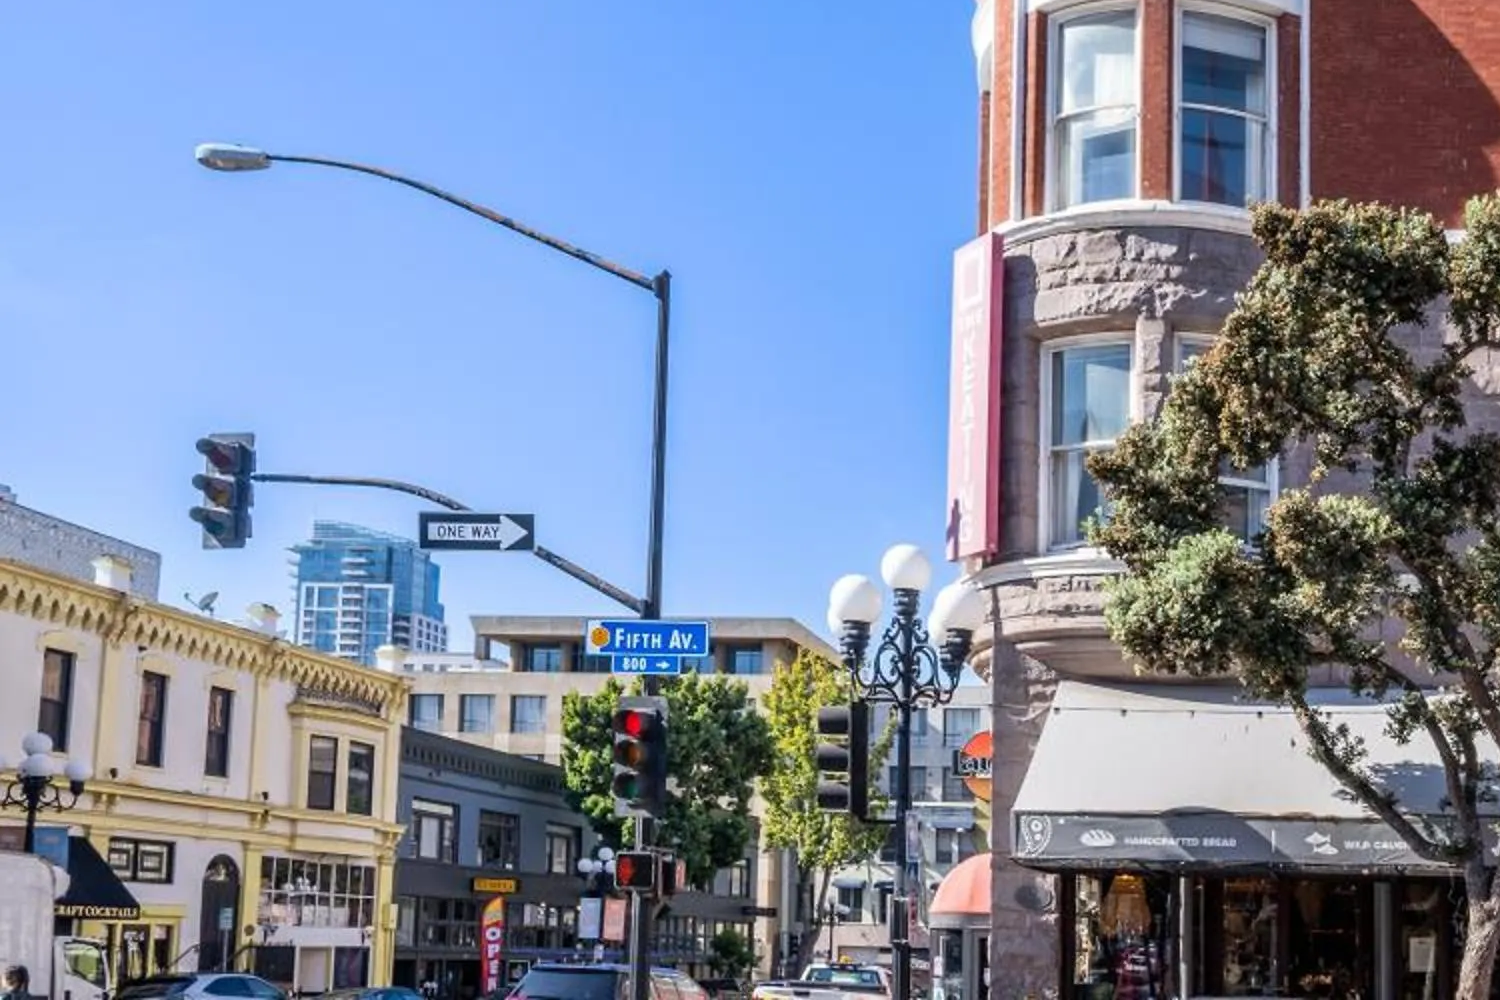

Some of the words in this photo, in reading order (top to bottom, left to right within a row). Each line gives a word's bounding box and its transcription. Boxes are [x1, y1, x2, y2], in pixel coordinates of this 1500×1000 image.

[437, 525, 465, 539] ONE
[471, 525, 500, 539] WAY
[615, 628, 662, 649] FIFTH
[668, 629, 697, 649] AV.
[623, 657, 647, 671] 800
[85, 905, 138, 917] COCKTAILS
[485, 927, 501, 993] OPEN
